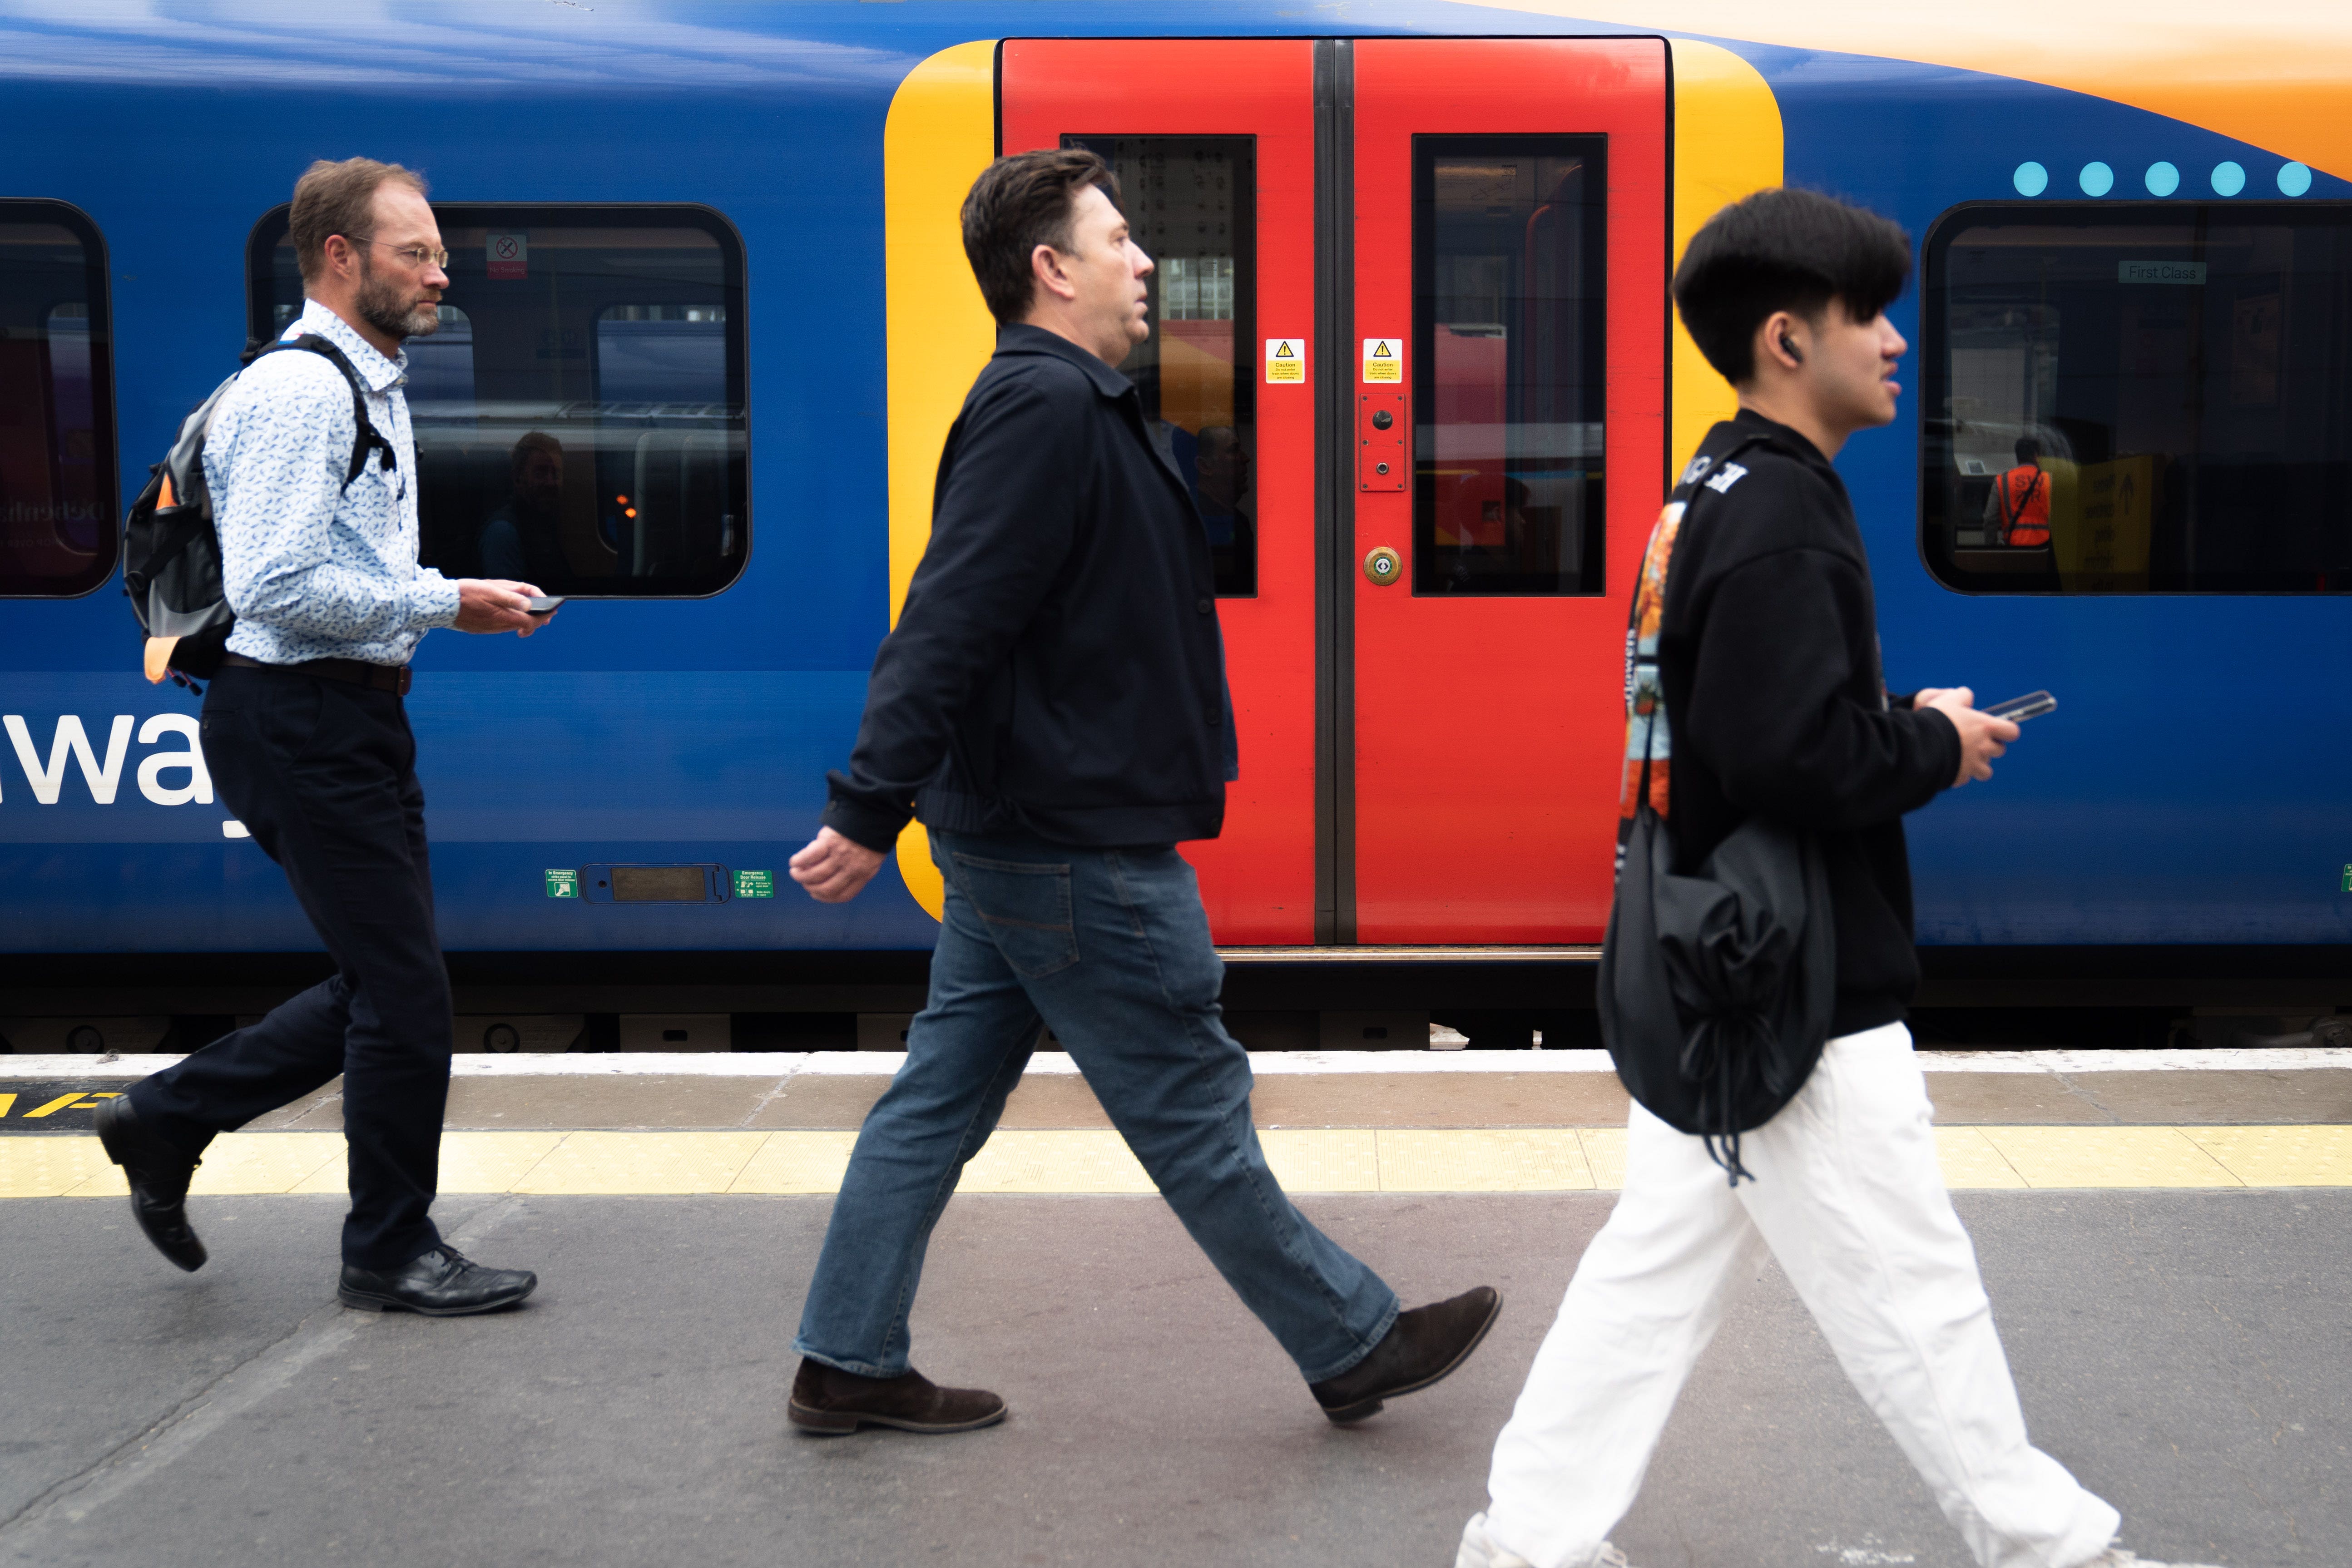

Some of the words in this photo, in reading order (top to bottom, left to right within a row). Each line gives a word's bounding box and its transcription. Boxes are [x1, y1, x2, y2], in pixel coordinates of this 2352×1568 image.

[2129, 266, 2158, 278] First
[2162, 266, 2196, 279] Class
[0, 713, 253, 838] wa
